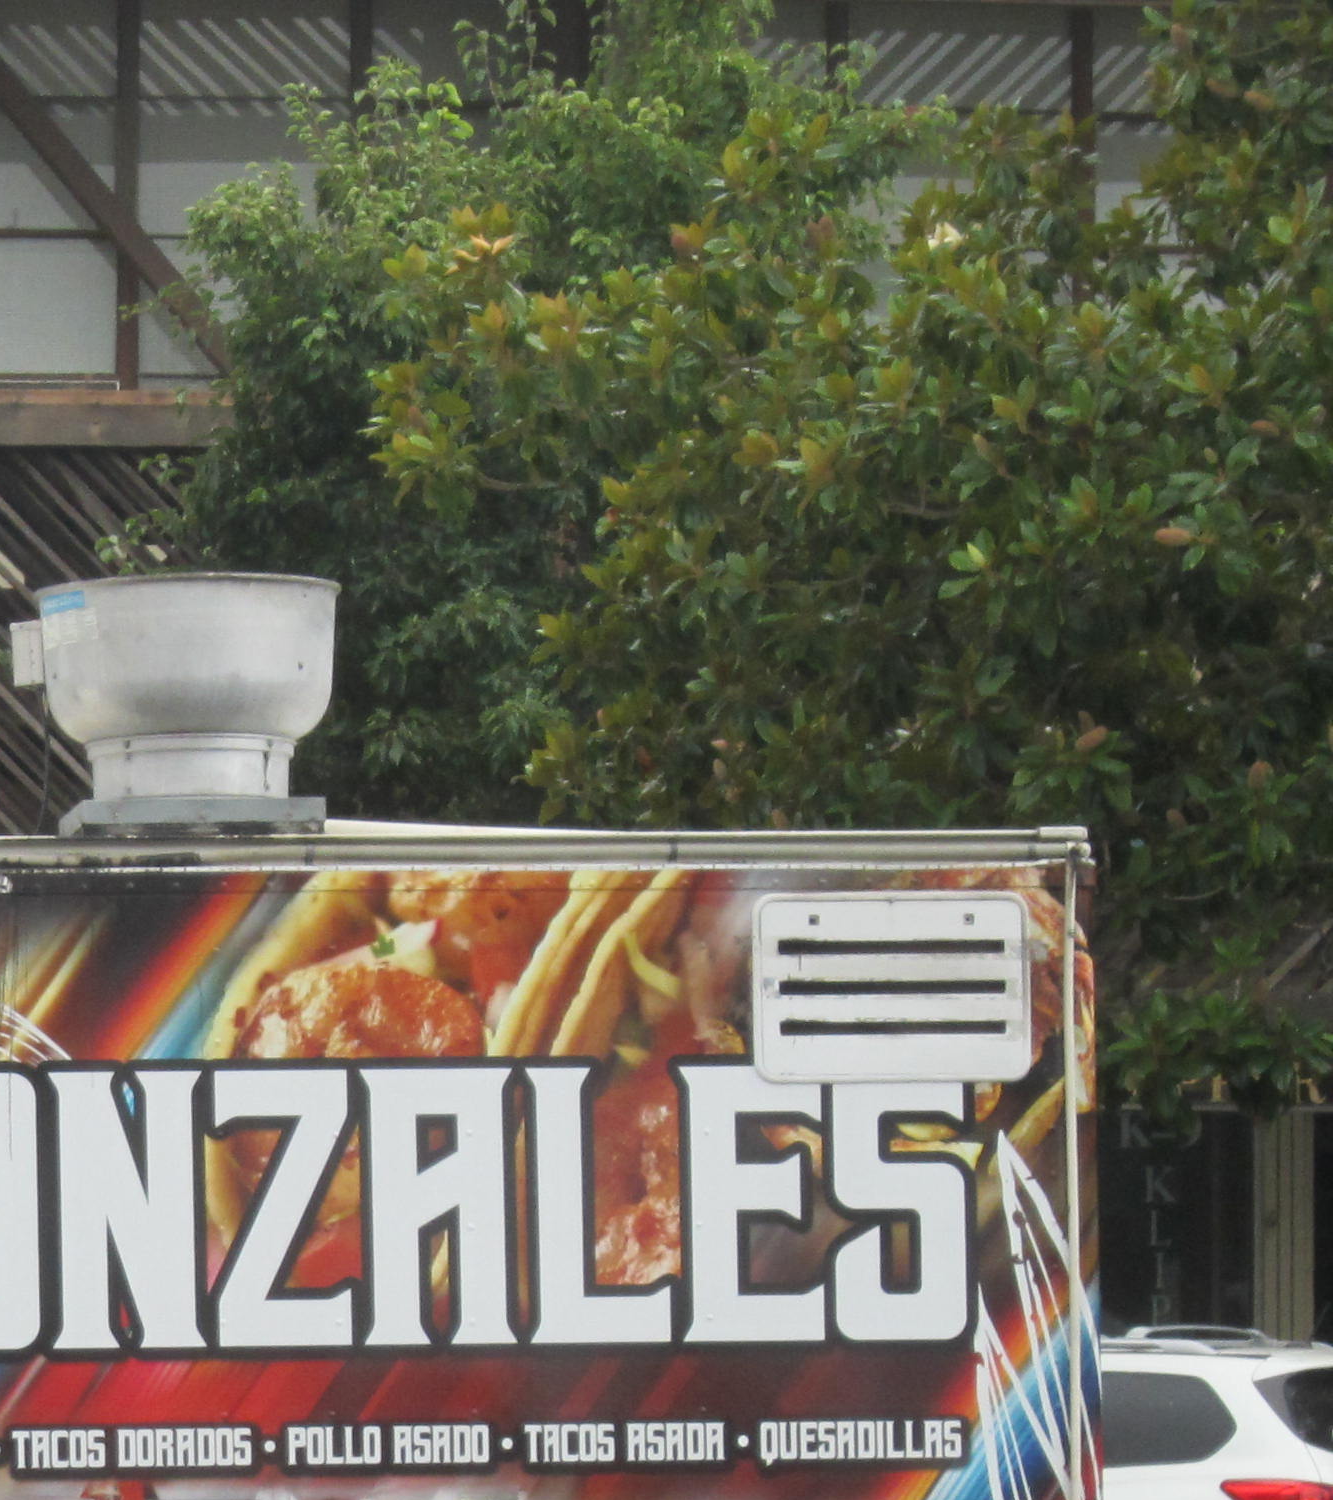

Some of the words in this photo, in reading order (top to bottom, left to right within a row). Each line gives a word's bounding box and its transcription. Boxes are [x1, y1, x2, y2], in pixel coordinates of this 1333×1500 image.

[11, 1430, 106, 1469] TACOS
[117, 1427, 252, 1468] DORADOS
[287, 1425, 382, 1465] POLLO
[393, 1425, 490, 1464] ASADO
[524, 1423, 615, 1463] TACOS
[627, 1422, 724, 1461] ASADA
[760, 1420, 962, 1465] QUESADILLAS
